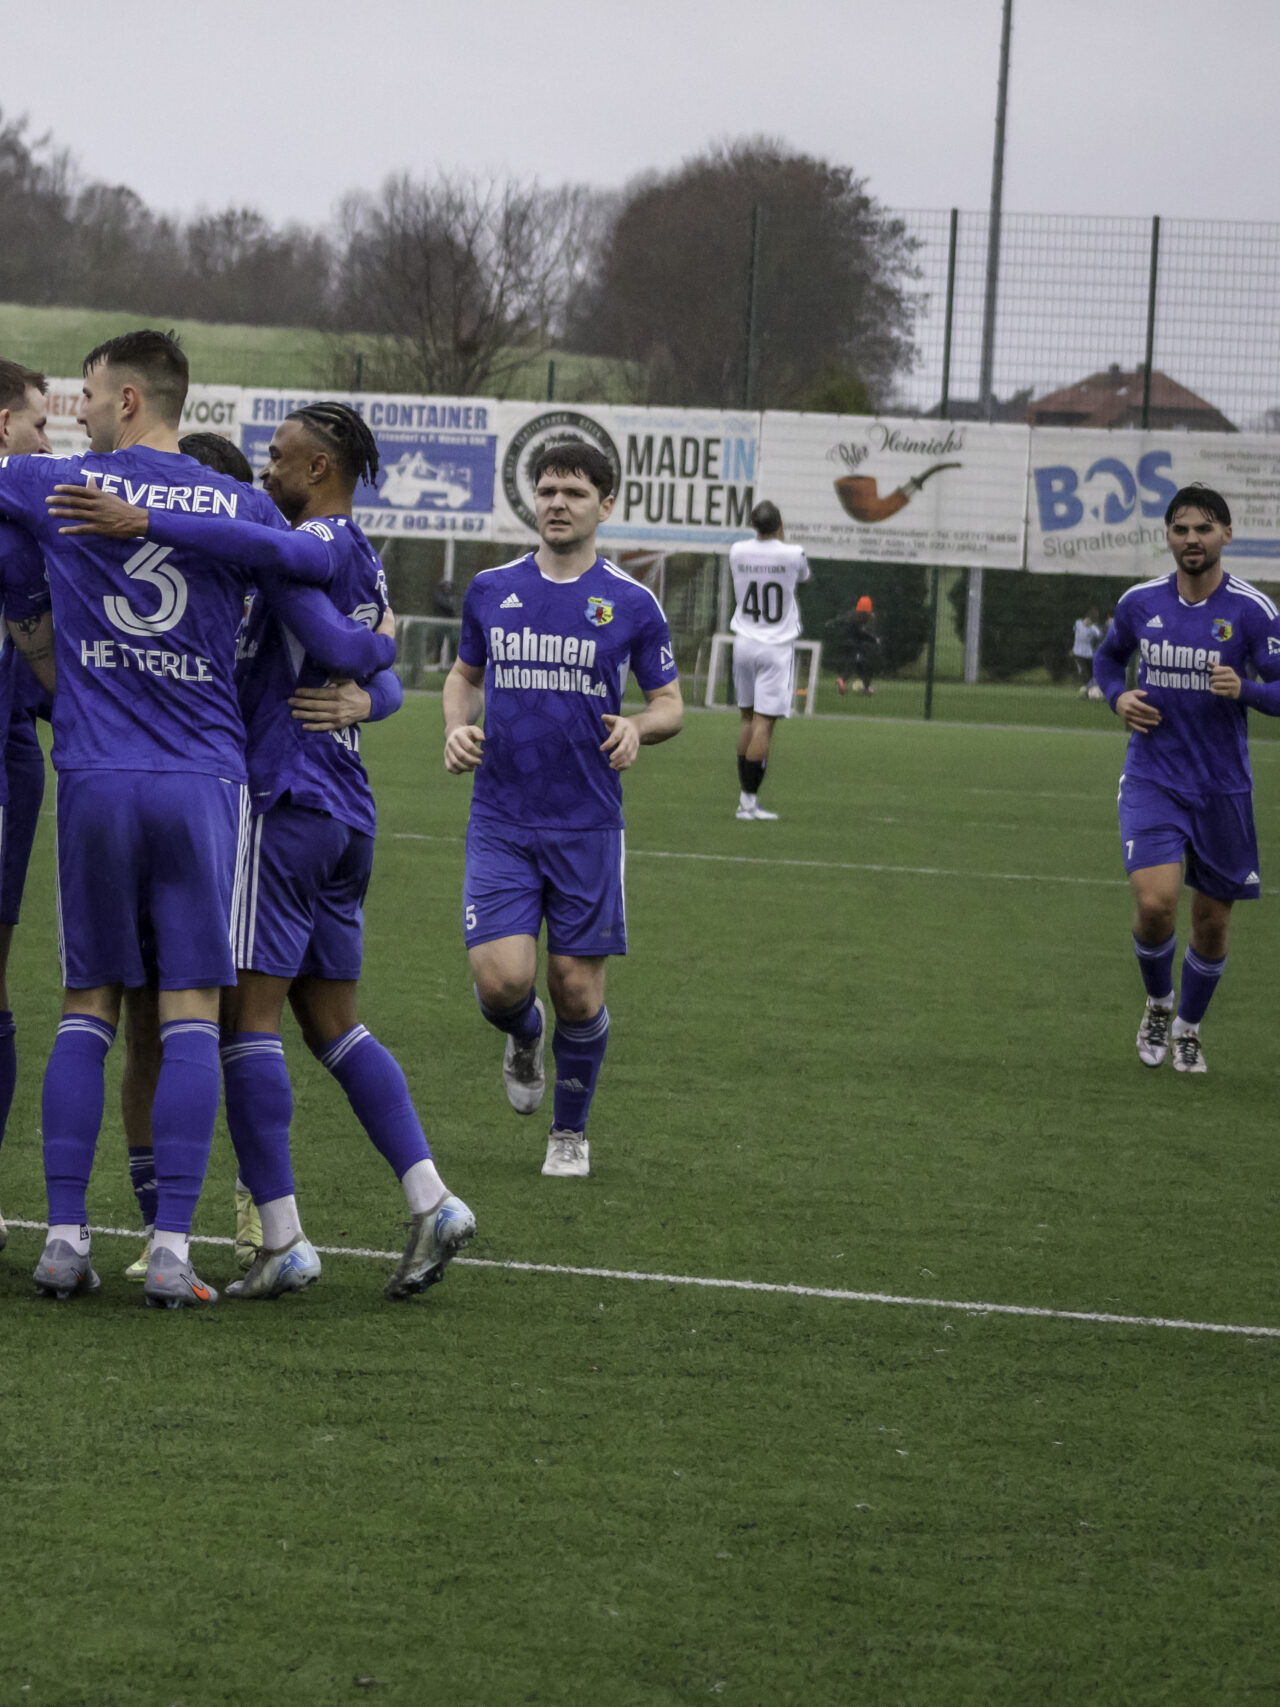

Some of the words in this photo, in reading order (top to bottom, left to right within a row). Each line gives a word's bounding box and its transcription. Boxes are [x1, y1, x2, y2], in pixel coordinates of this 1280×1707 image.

[183, 401, 236, 424] VOGT
[370, 402, 488, 430] CONTAINER
[623, 481, 754, 528] PULLEM
[1042, 525, 1166, 559] Signaltechn
[103, 537, 189, 638] 3
[742, 581, 784, 624] 40
[80, 639, 213, 682] HETTERLE
[490, 626, 597, 668] Rahmen
[1140, 638, 1221, 672] Rahmen
[1145, 666, 1211, 691] Automobil
[465, 904, 477, 930] 5
